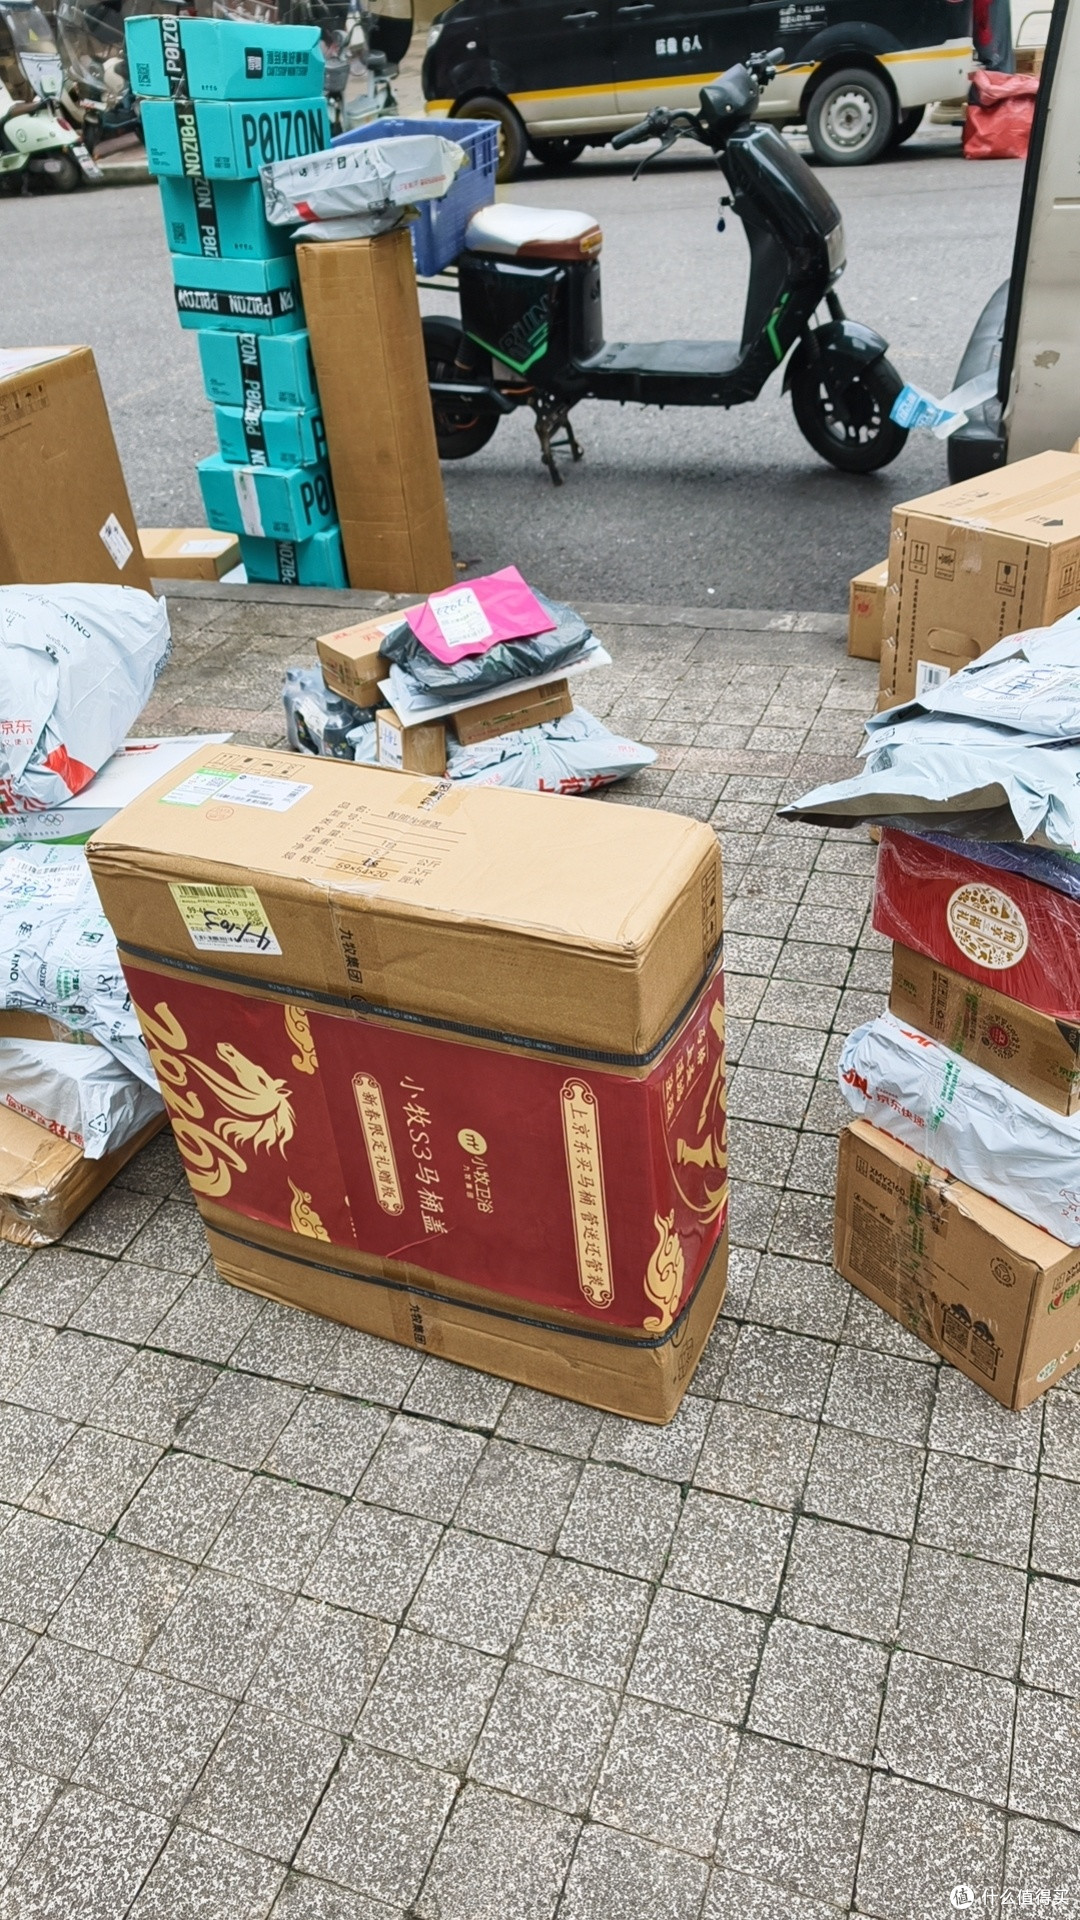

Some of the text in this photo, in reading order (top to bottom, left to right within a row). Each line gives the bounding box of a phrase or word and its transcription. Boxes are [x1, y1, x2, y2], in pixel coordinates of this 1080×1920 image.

[178, 114, 202, 178] POIZON
[241, 107, 325, 169] POIZON
[228, 294, 274, 316] POIZON
[61, 612, 92, 639] ONLY
[9, 952, 21, 982] ONLY
[338, 926, 364, 985] 九牧集团
[876, 1093, 926, 1128] 京东快递
[361, 1090, 397, 1200] 新春限定礼赠版
[399, 1074, 450, 1234] 小牧S3马桶盖
[470, 1155, 495, 1214] 小牧卫浴
[570, 1102, 604, 1287] 上京东买马桶 管送还管装
[408, 1301, 427, 1346] 九牧集团
